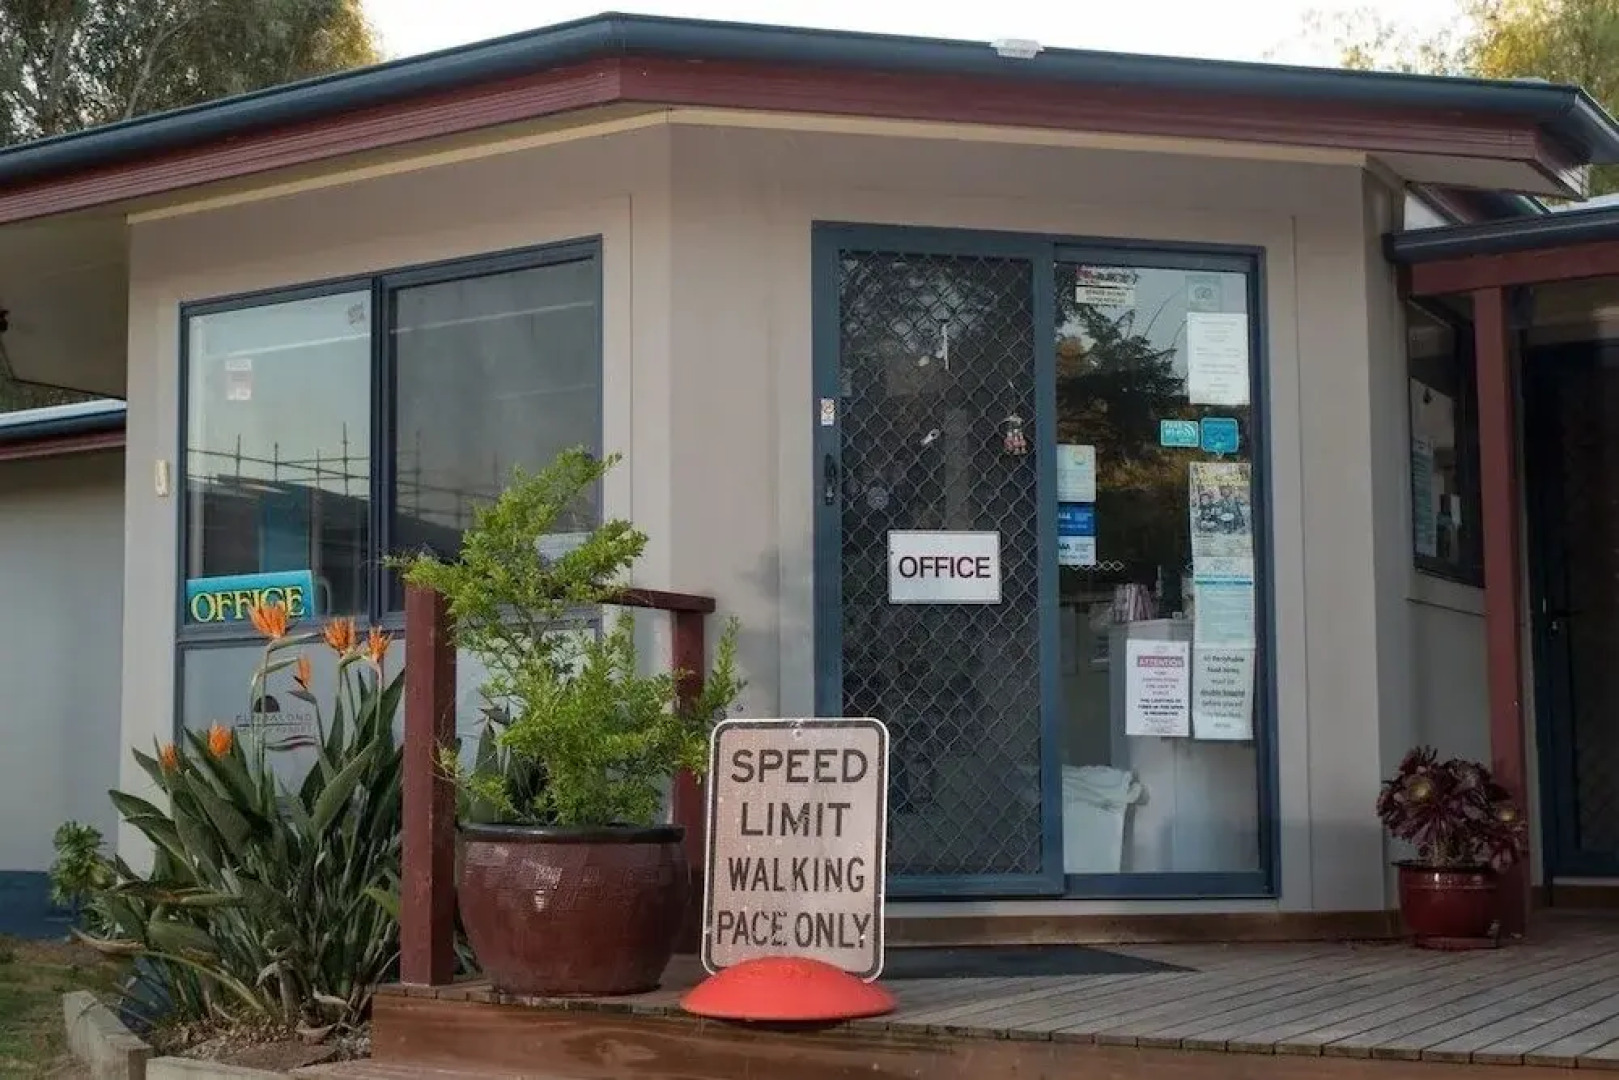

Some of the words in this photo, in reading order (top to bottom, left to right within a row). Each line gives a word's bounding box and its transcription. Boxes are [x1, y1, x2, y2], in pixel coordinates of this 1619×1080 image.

[899, 556, 991, 579] OFFICE
[190, 585, 305, 623] OFFICE
[731, 749, 868, 783] SPEED
[741, 802, 851, 837] LIMIT
[728, 857, 865, 893] WALKING
[717, 909, 787, 947] PACE
[794, 912, 871, 949] ONLY
